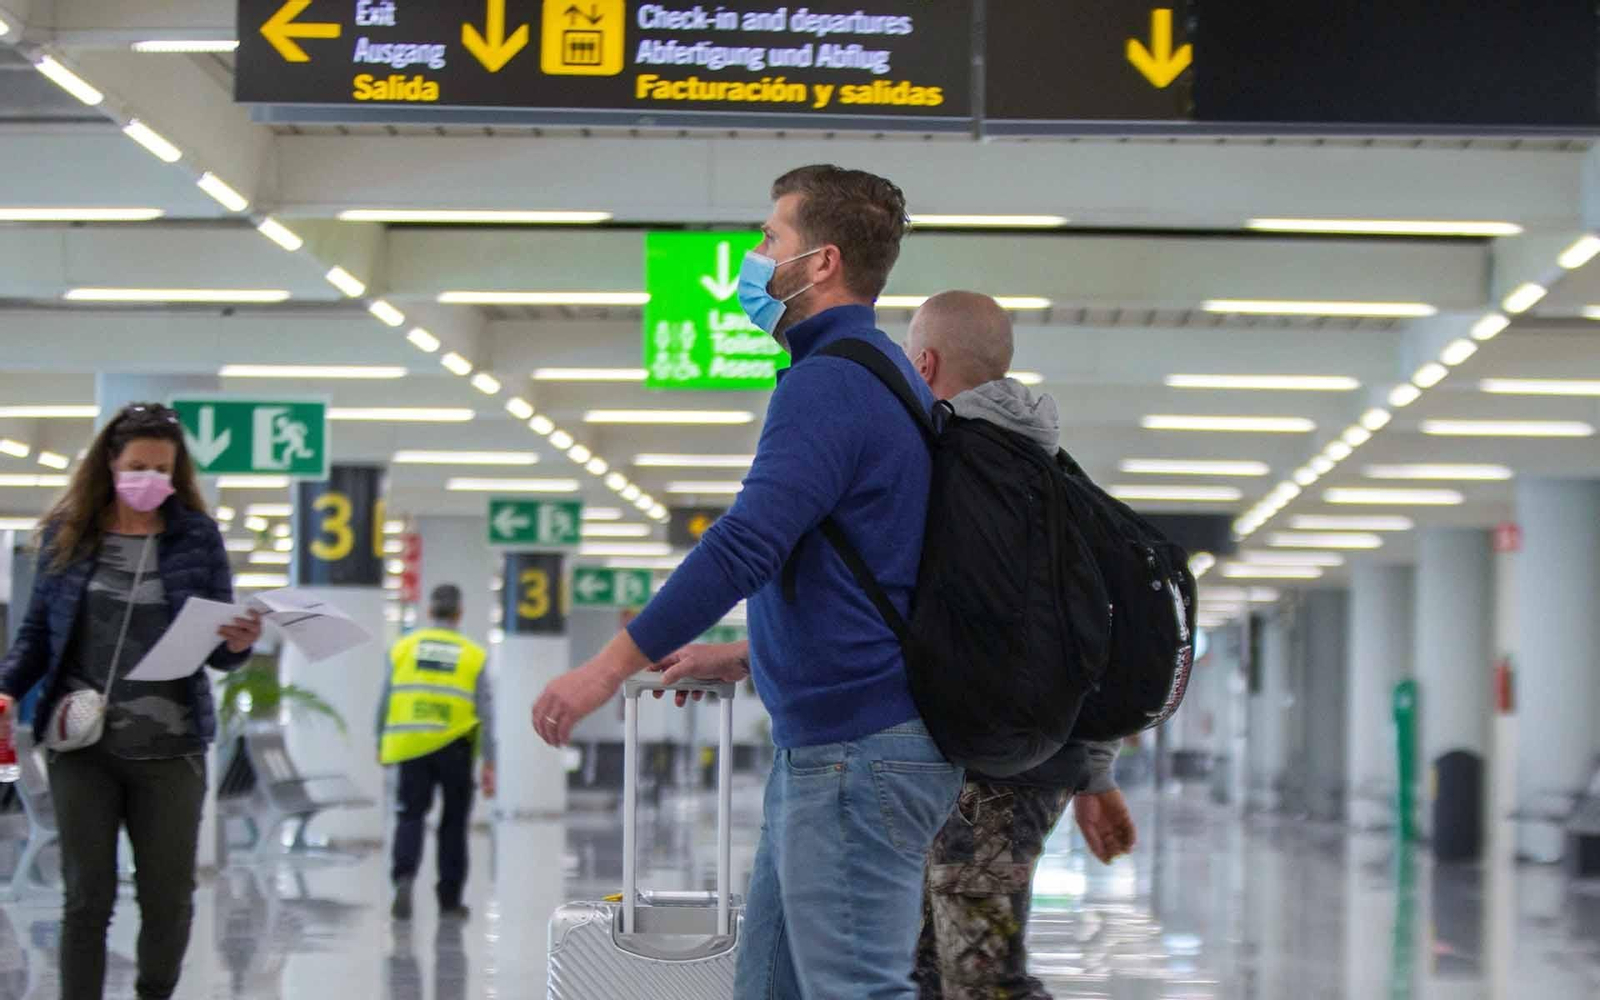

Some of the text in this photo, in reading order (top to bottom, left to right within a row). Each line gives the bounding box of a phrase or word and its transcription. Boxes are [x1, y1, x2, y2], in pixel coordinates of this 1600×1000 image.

[356, 0, 396, 26] Exit
[637, 4, 913, 37] Check-in and departures
[353, 37, 446, 69] Ausgang
[635, 39, 891, 74] Abfertigung und Abflug
[353, 73, 439, 101] Salida
[635, 74, 944, 108] Facturación y salidas
[310, 493, 354, 561] 3
[517, 569, 549, 619] 3
